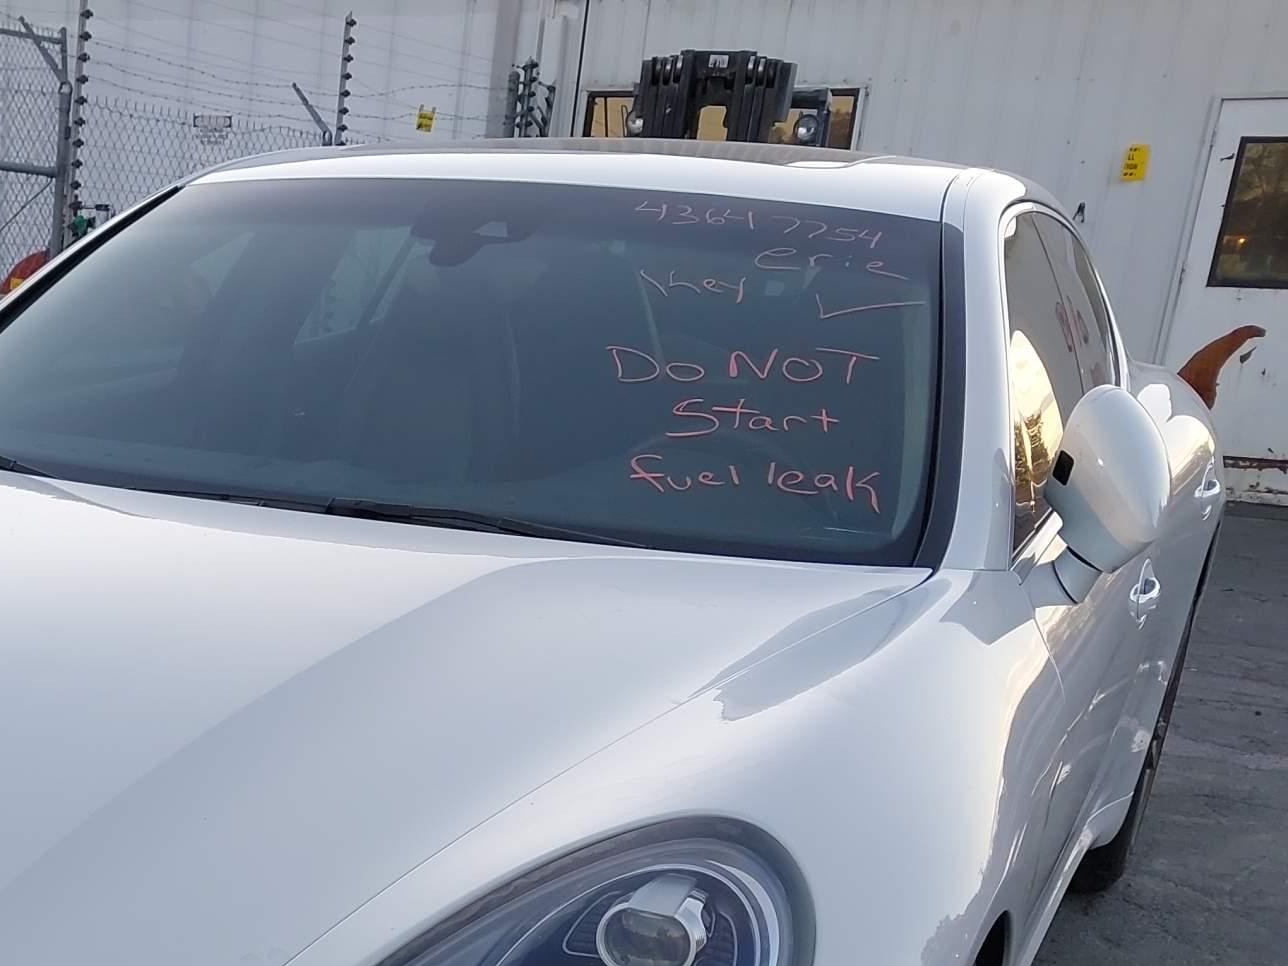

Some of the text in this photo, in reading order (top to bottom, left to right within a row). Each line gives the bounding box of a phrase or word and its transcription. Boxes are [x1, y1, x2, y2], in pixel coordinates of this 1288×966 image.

[728, 347, 881, 385] NOT
[665, 398, 840, 437] Start
[767, 461, 881, 515] leak
